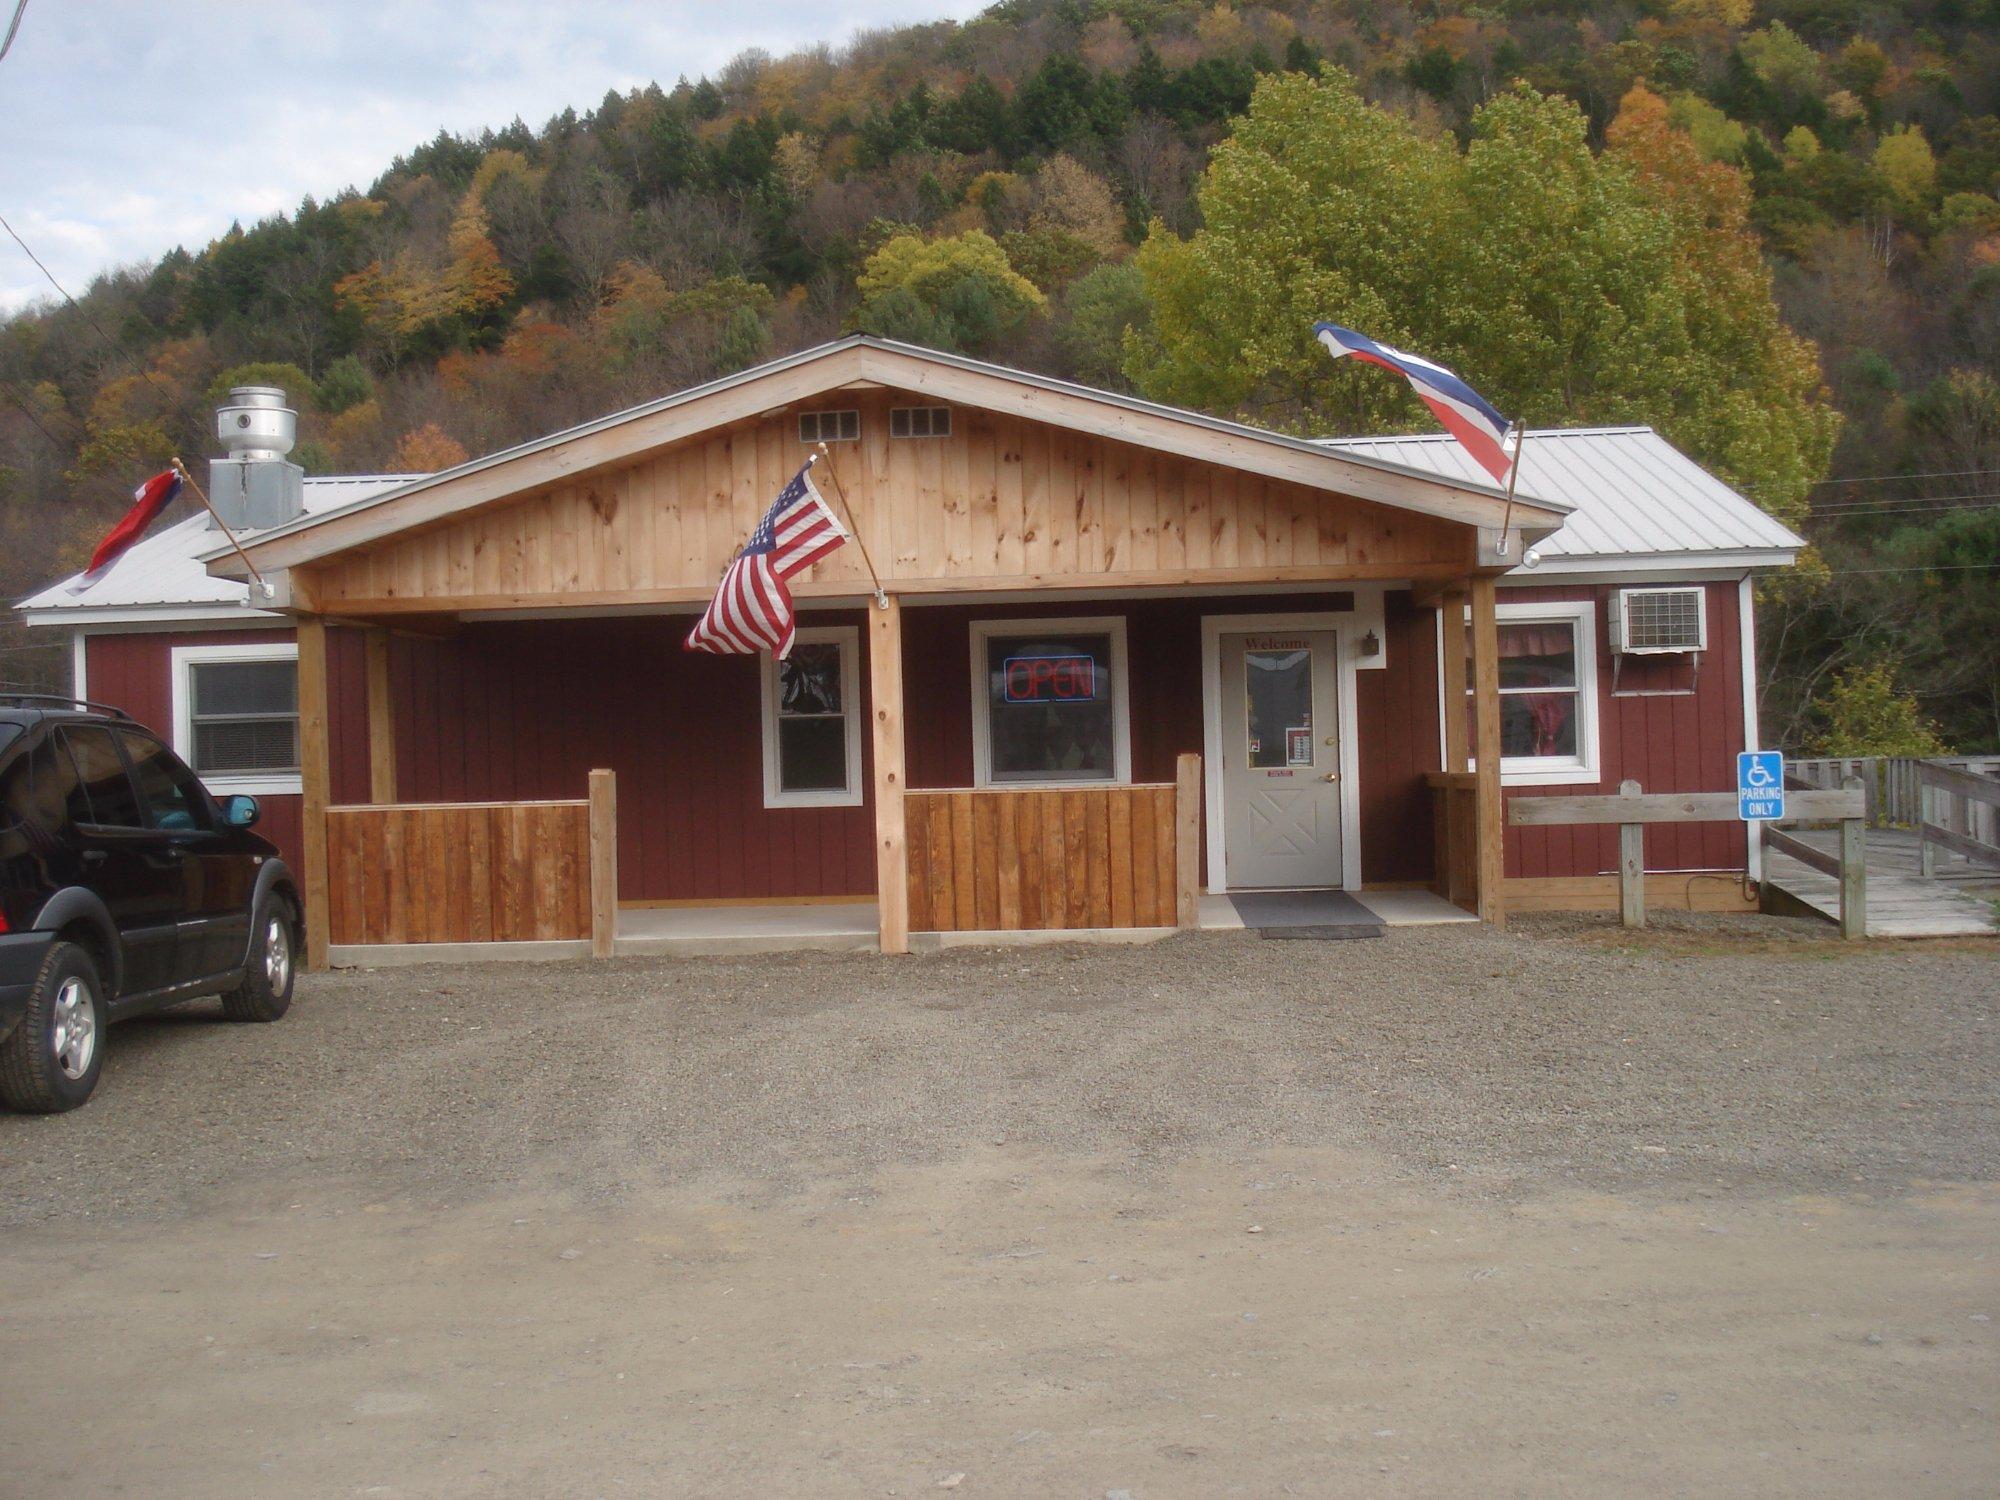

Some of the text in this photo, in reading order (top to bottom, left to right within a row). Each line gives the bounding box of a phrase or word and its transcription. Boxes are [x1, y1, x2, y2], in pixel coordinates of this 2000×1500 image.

[1245, 637, 1311, 650] Welcome
[1008, 659, 1092, 699] OPEN
[1741, 787, 1781, 800] PARKING
[1749, 802, 1774, 815] ONLY
